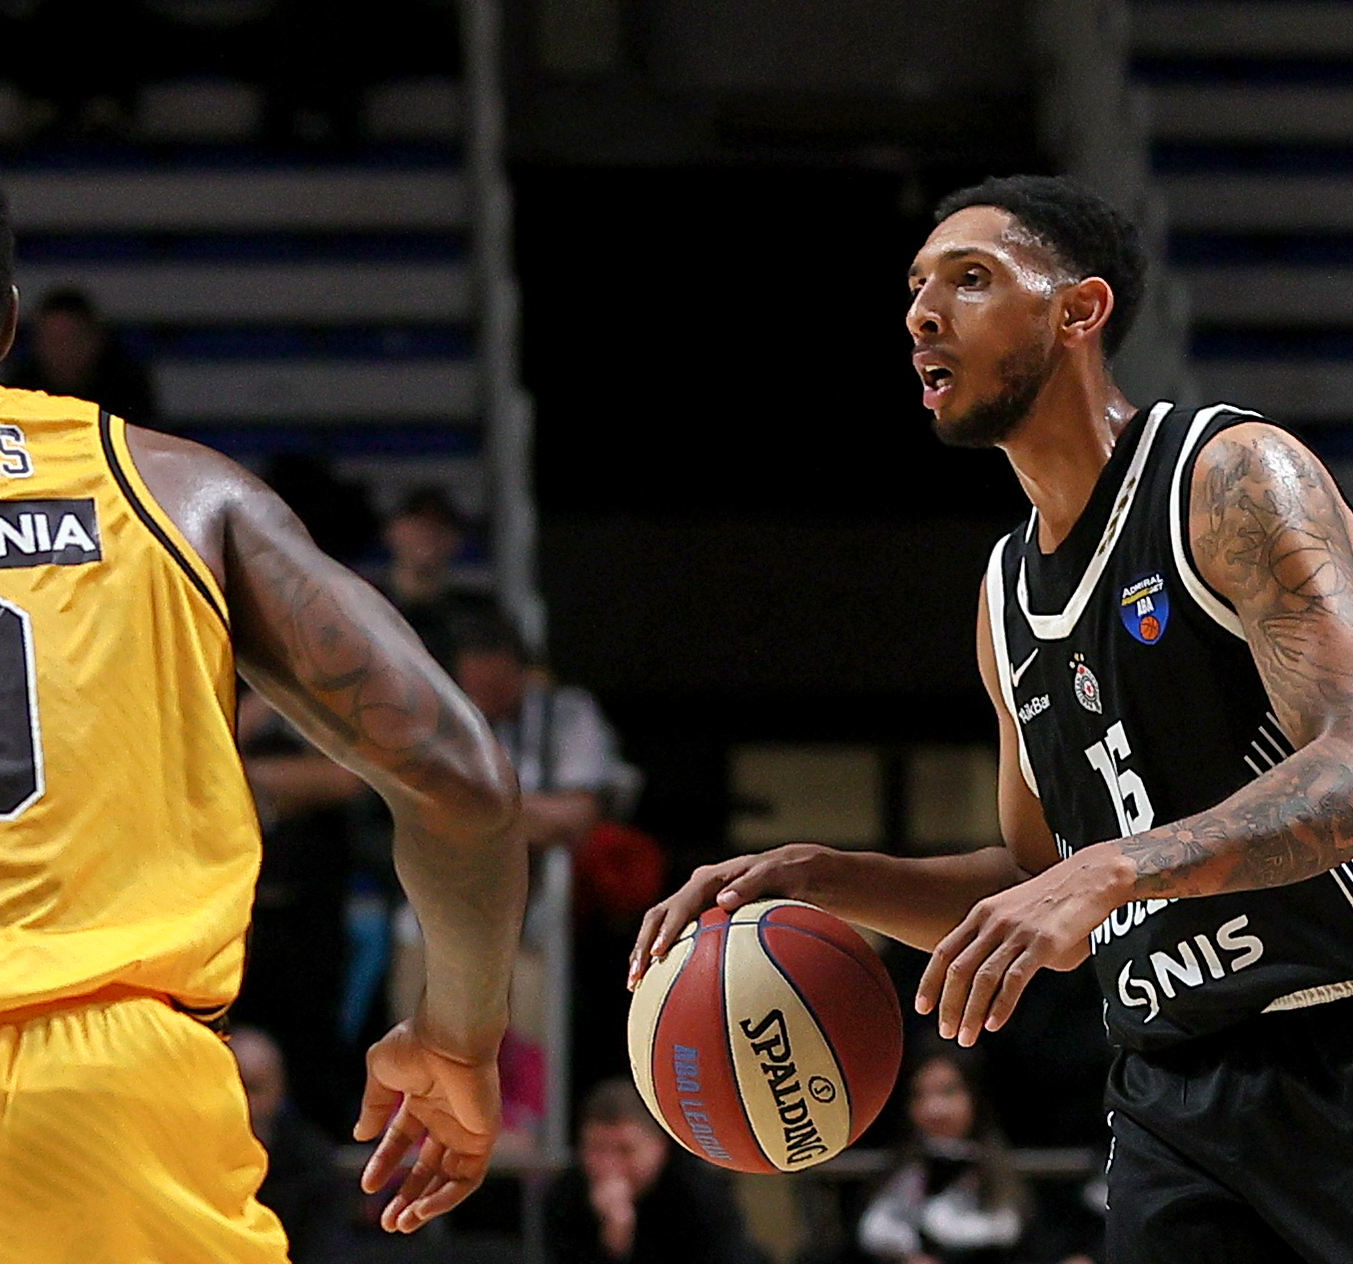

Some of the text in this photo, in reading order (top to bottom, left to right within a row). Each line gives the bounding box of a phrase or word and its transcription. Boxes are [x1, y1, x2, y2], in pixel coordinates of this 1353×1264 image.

[1137, 595, 1156, 617] ABA
[1084, 720, 1155, 838] 15
[1150, 914, 1265, 999] NIS
[672, 1044, 700, 1093] ABA
[739, 1008, 829, 1165] SPALDING
